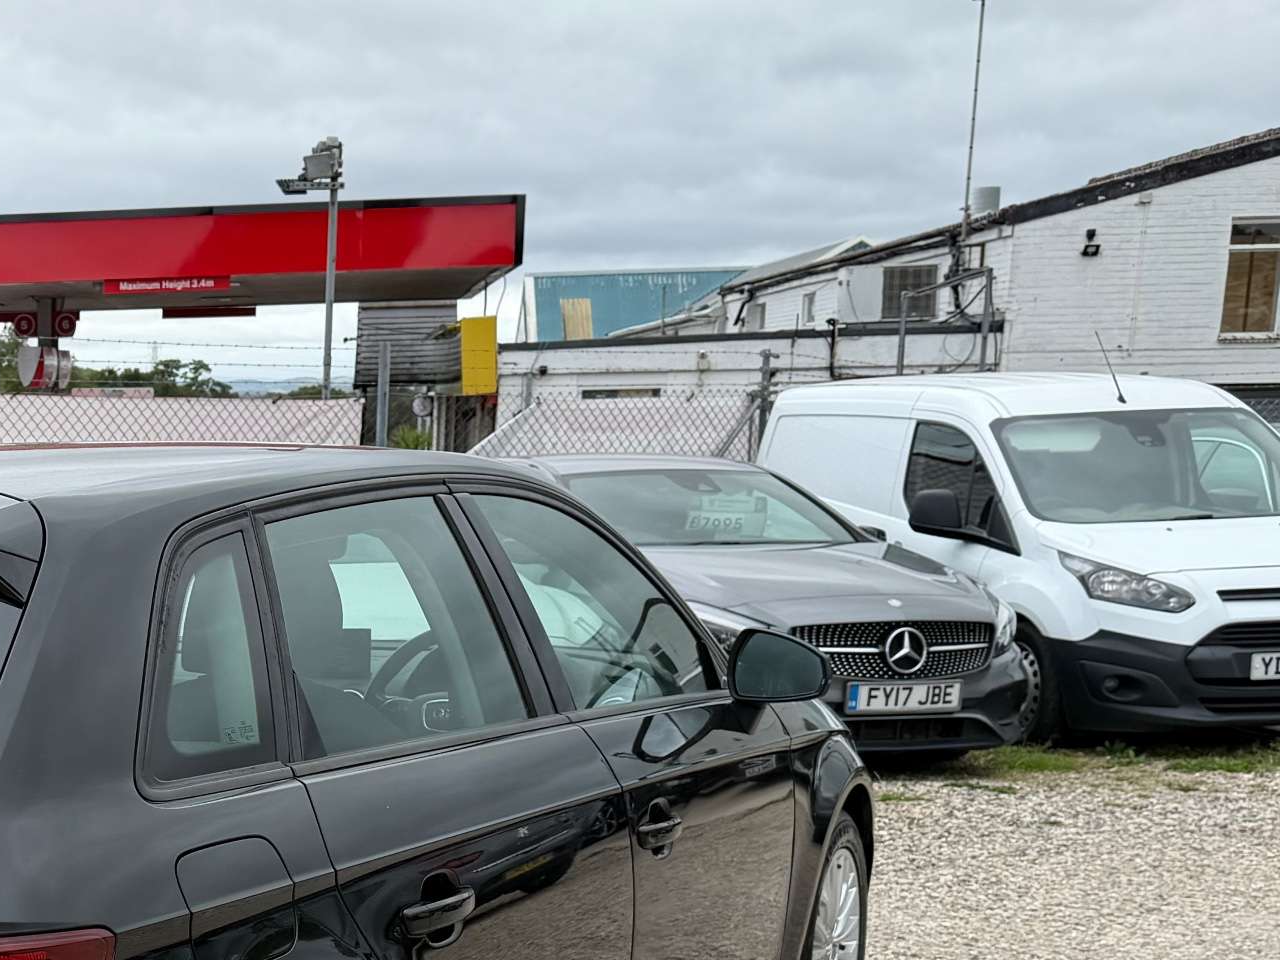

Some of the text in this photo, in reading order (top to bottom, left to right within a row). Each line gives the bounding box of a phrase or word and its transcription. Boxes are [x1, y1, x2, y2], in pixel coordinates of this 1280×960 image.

[119, 279, 215, 291] Maximum Height 3.4m
[866, 686, 913, 707] FY17
[918, 684, 954, 706] JBE
